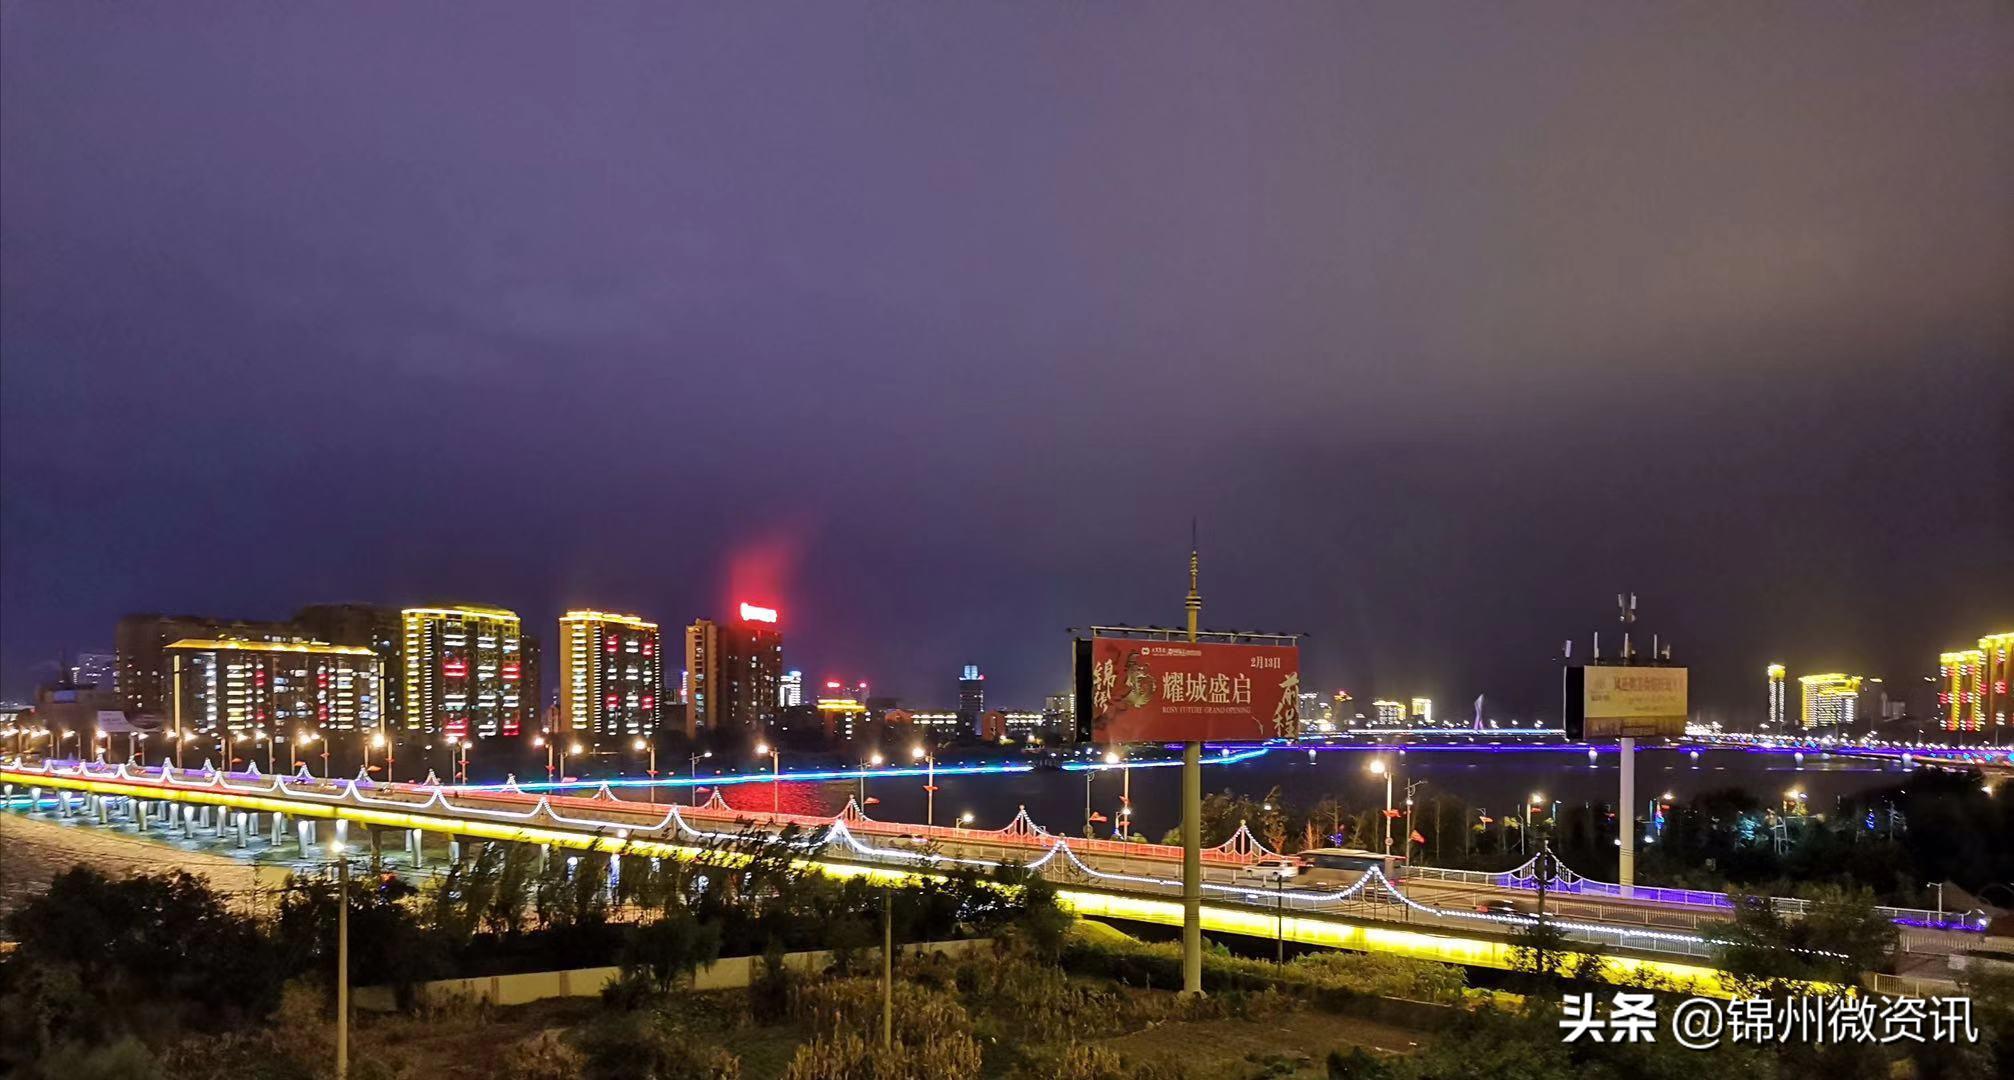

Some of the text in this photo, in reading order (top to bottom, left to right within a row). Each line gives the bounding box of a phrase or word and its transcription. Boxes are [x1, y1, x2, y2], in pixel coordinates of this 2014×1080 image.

[1250, 656, 1281, 669] 2月13日
[1162, 671, 1251, 705] 耀城盛启
